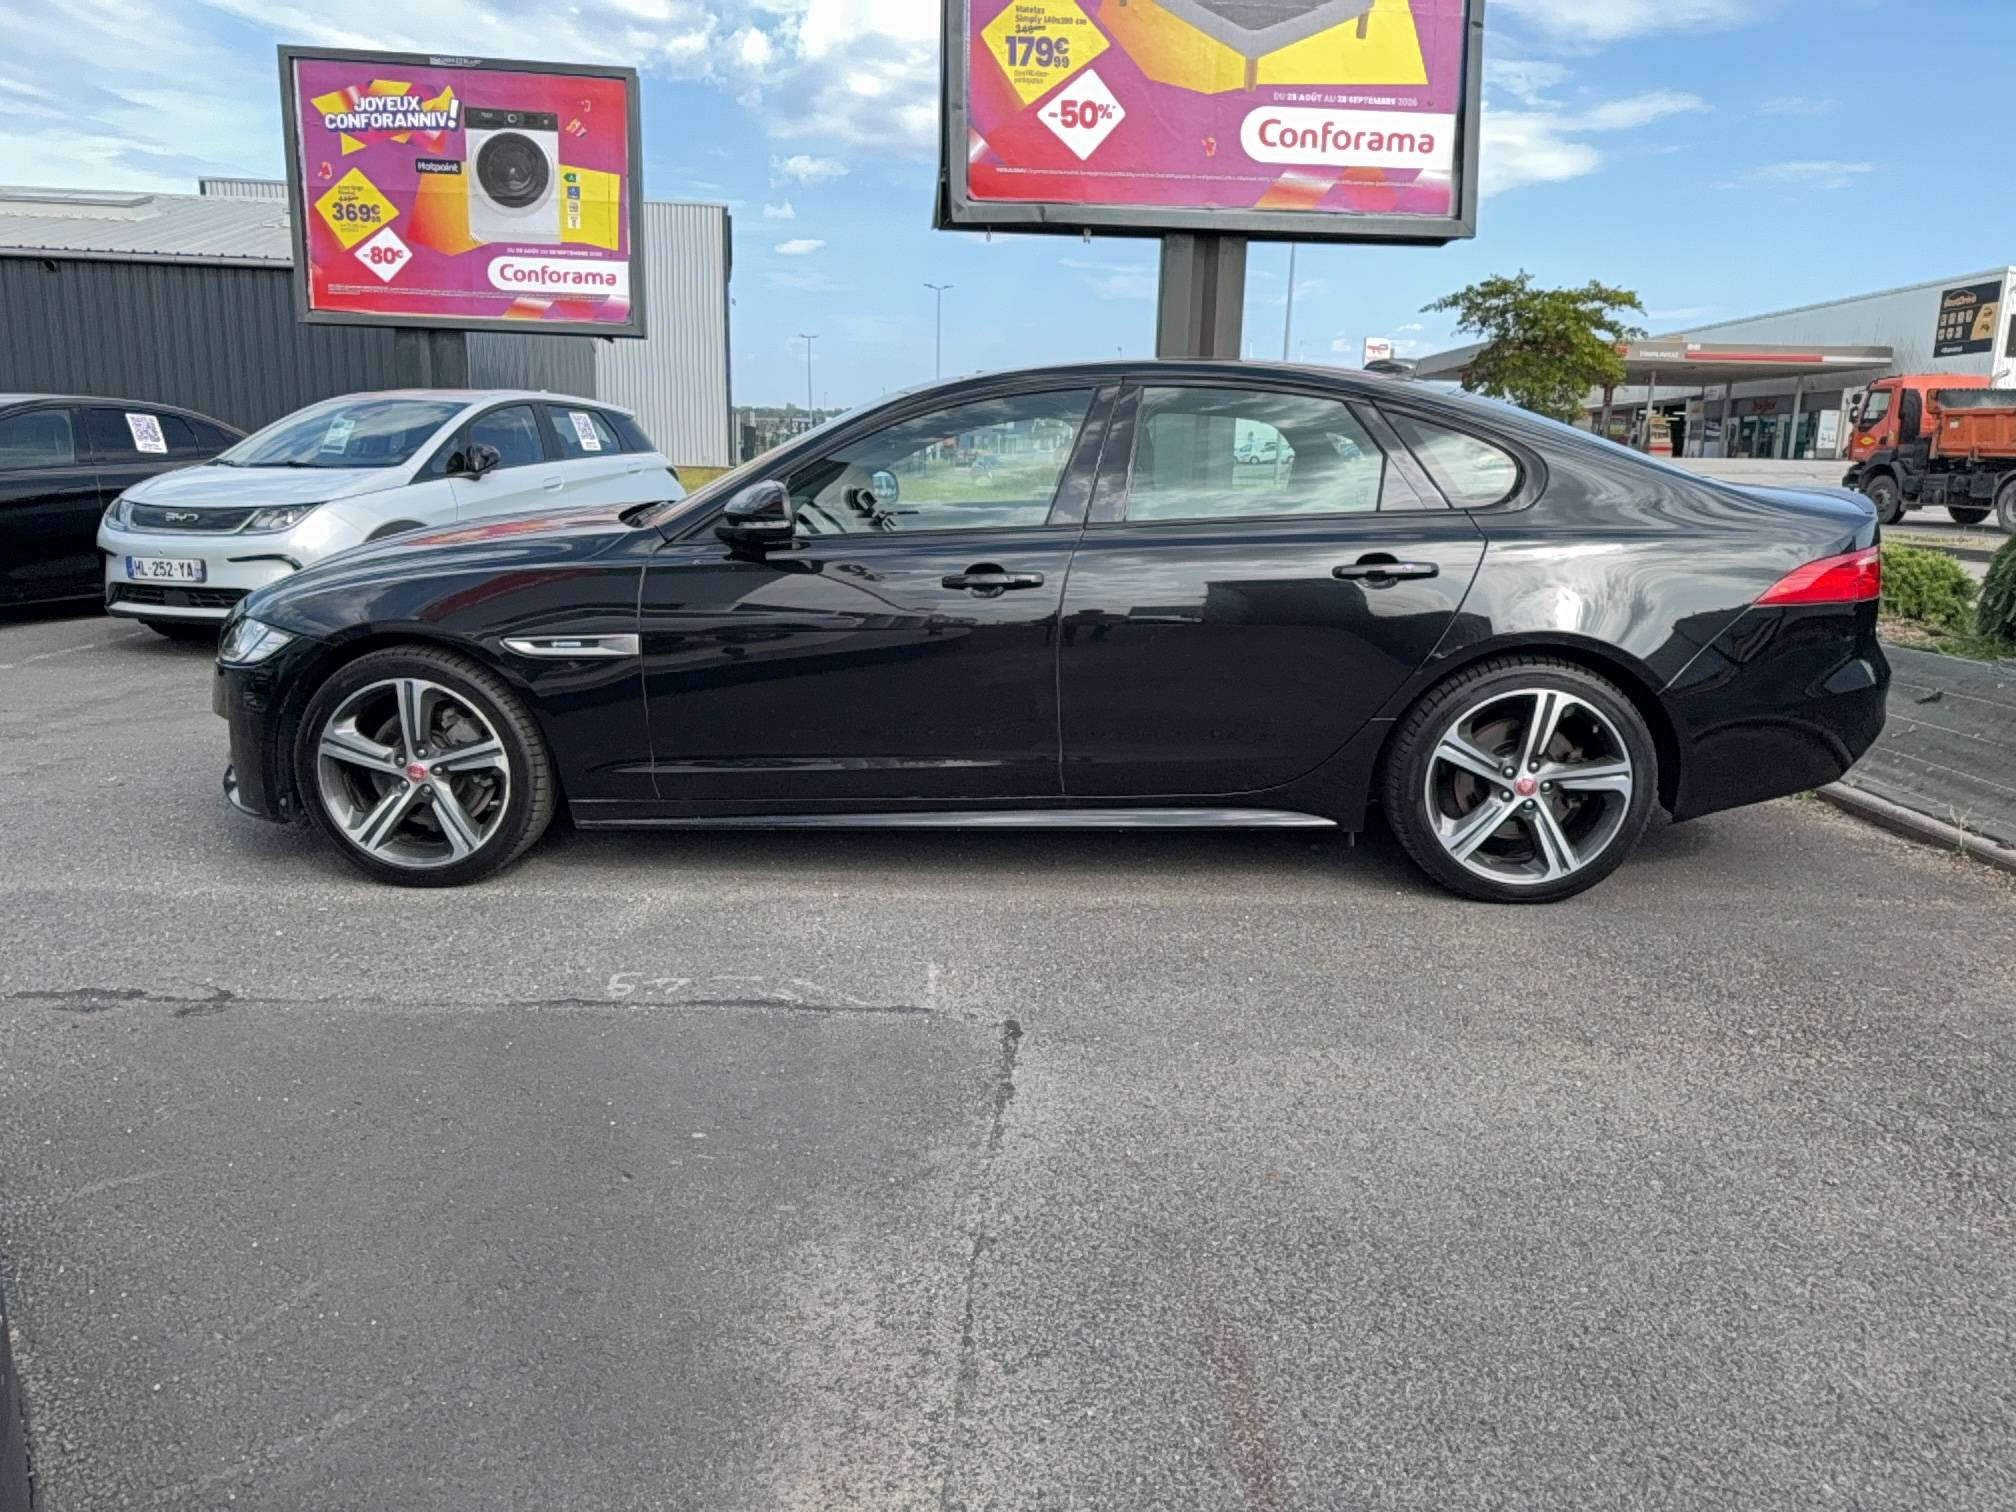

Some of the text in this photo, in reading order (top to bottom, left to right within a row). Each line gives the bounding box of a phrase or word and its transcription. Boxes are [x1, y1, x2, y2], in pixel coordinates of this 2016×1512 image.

[354, 96, 420, 112] JOYEUX
[1273, 92, 1285, 101] DU
[1348, 96, 1396, 105] SEPTEMBRE
[1259, 118, 1435, 154] Conforama
[500, 263, 617, 287] Conforama
[165, 511, 199, 522] BYD
